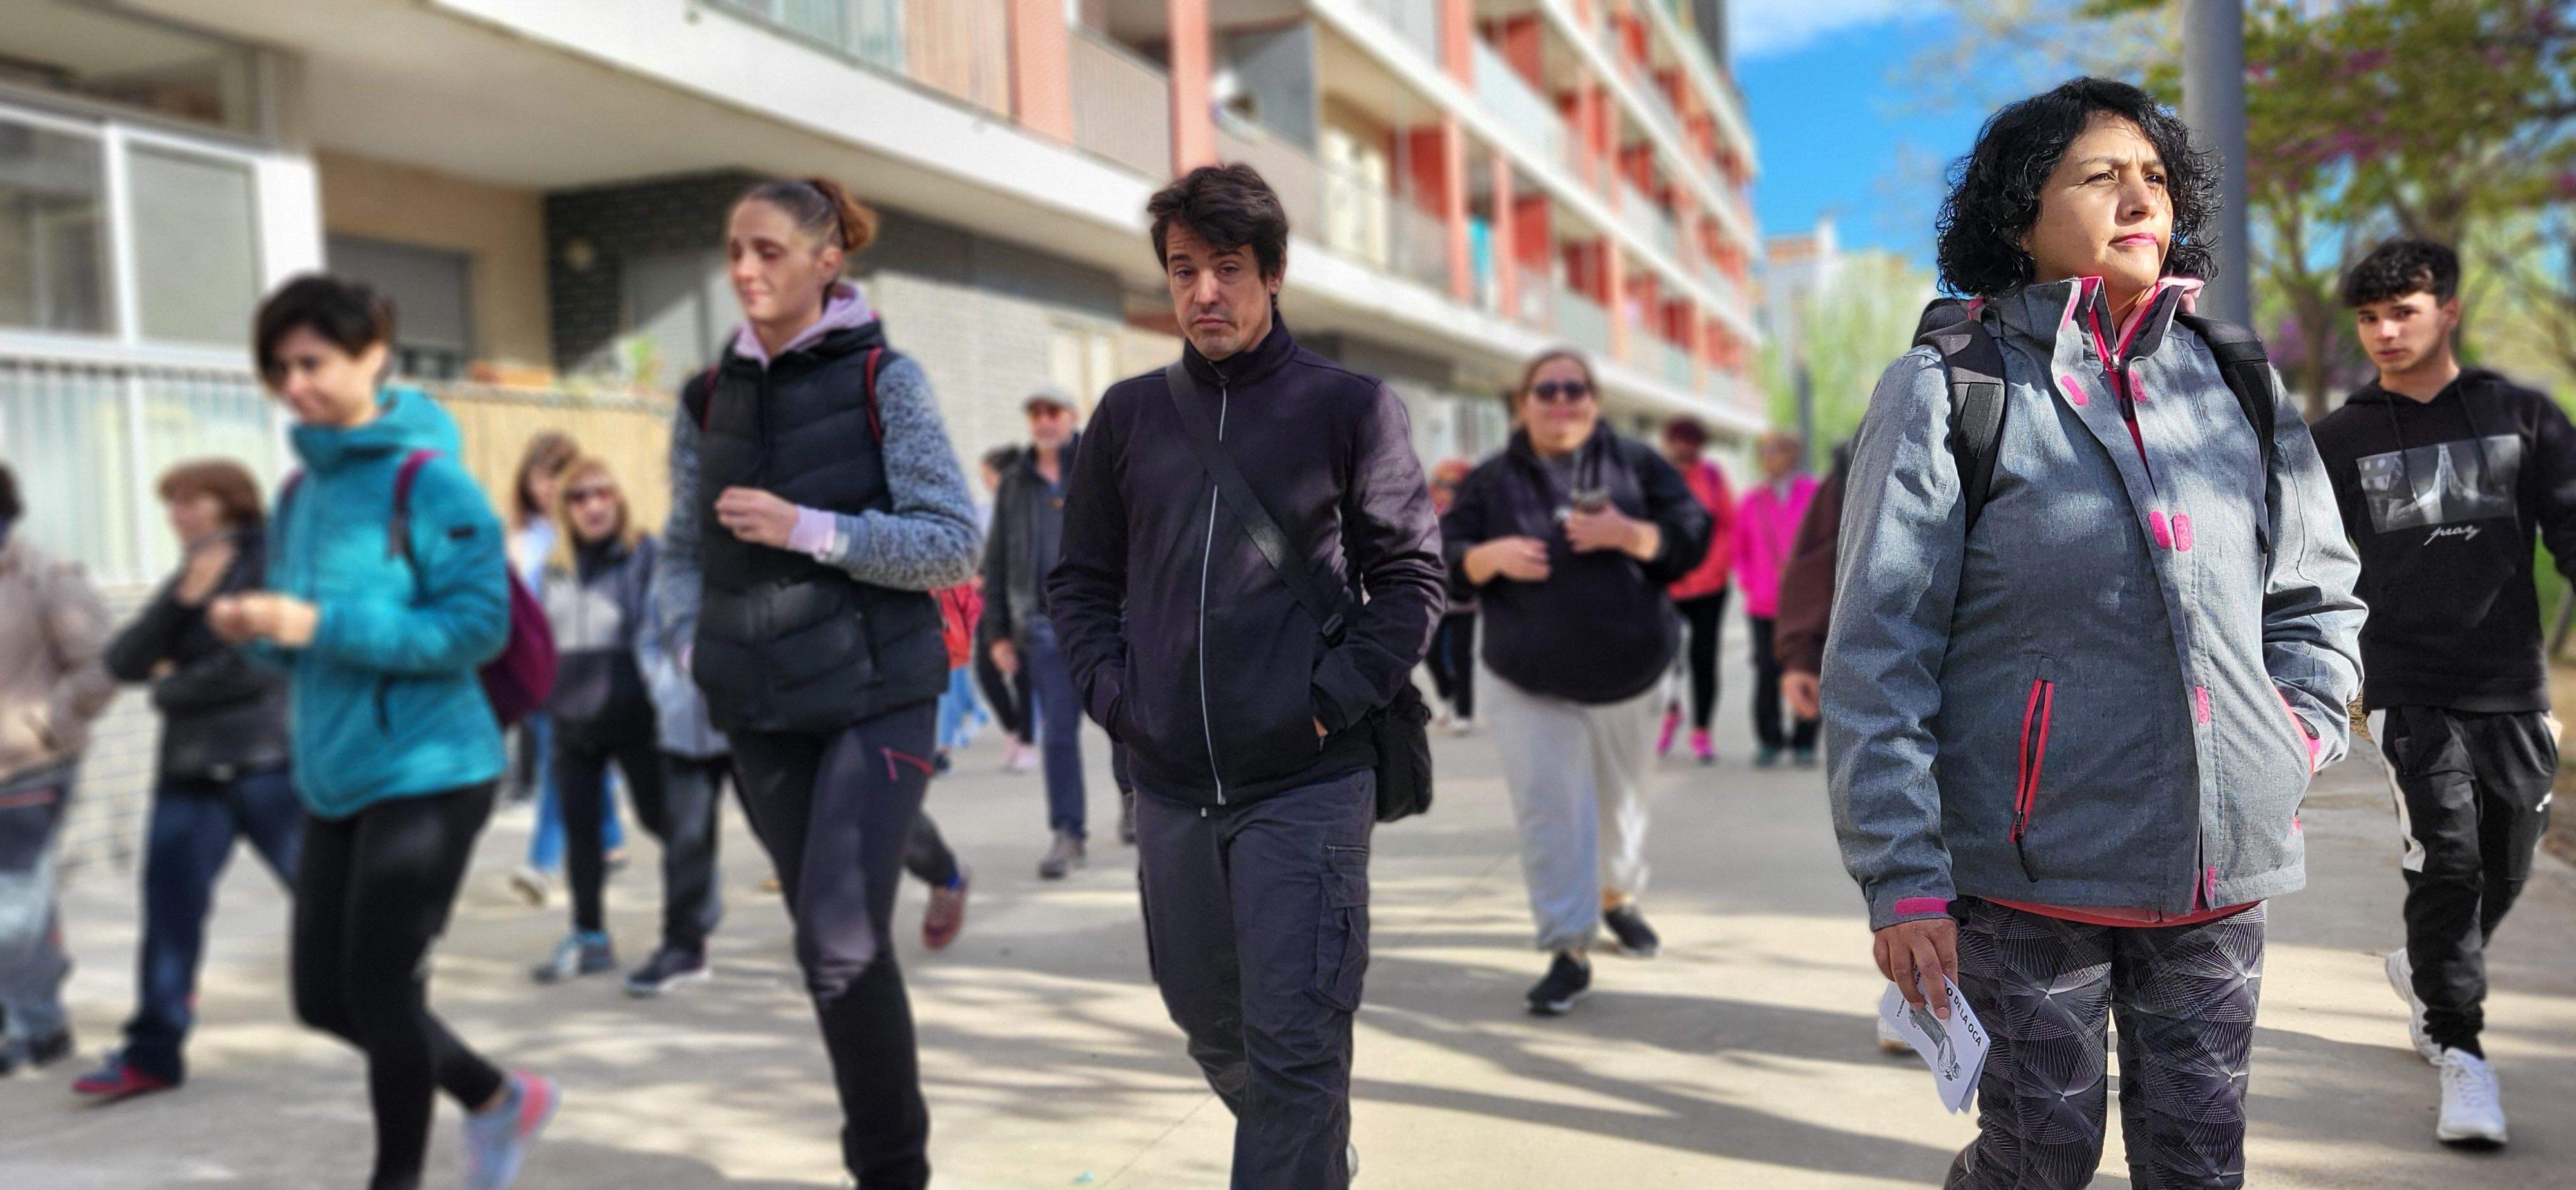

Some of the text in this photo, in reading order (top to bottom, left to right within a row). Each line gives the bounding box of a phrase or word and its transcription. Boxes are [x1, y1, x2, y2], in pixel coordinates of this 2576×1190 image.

[1954, 996, 1962, 1010] DE
[1960, 1009, 1968, 1025] LA
[1968, 1023, 1982, 1047] OCA
